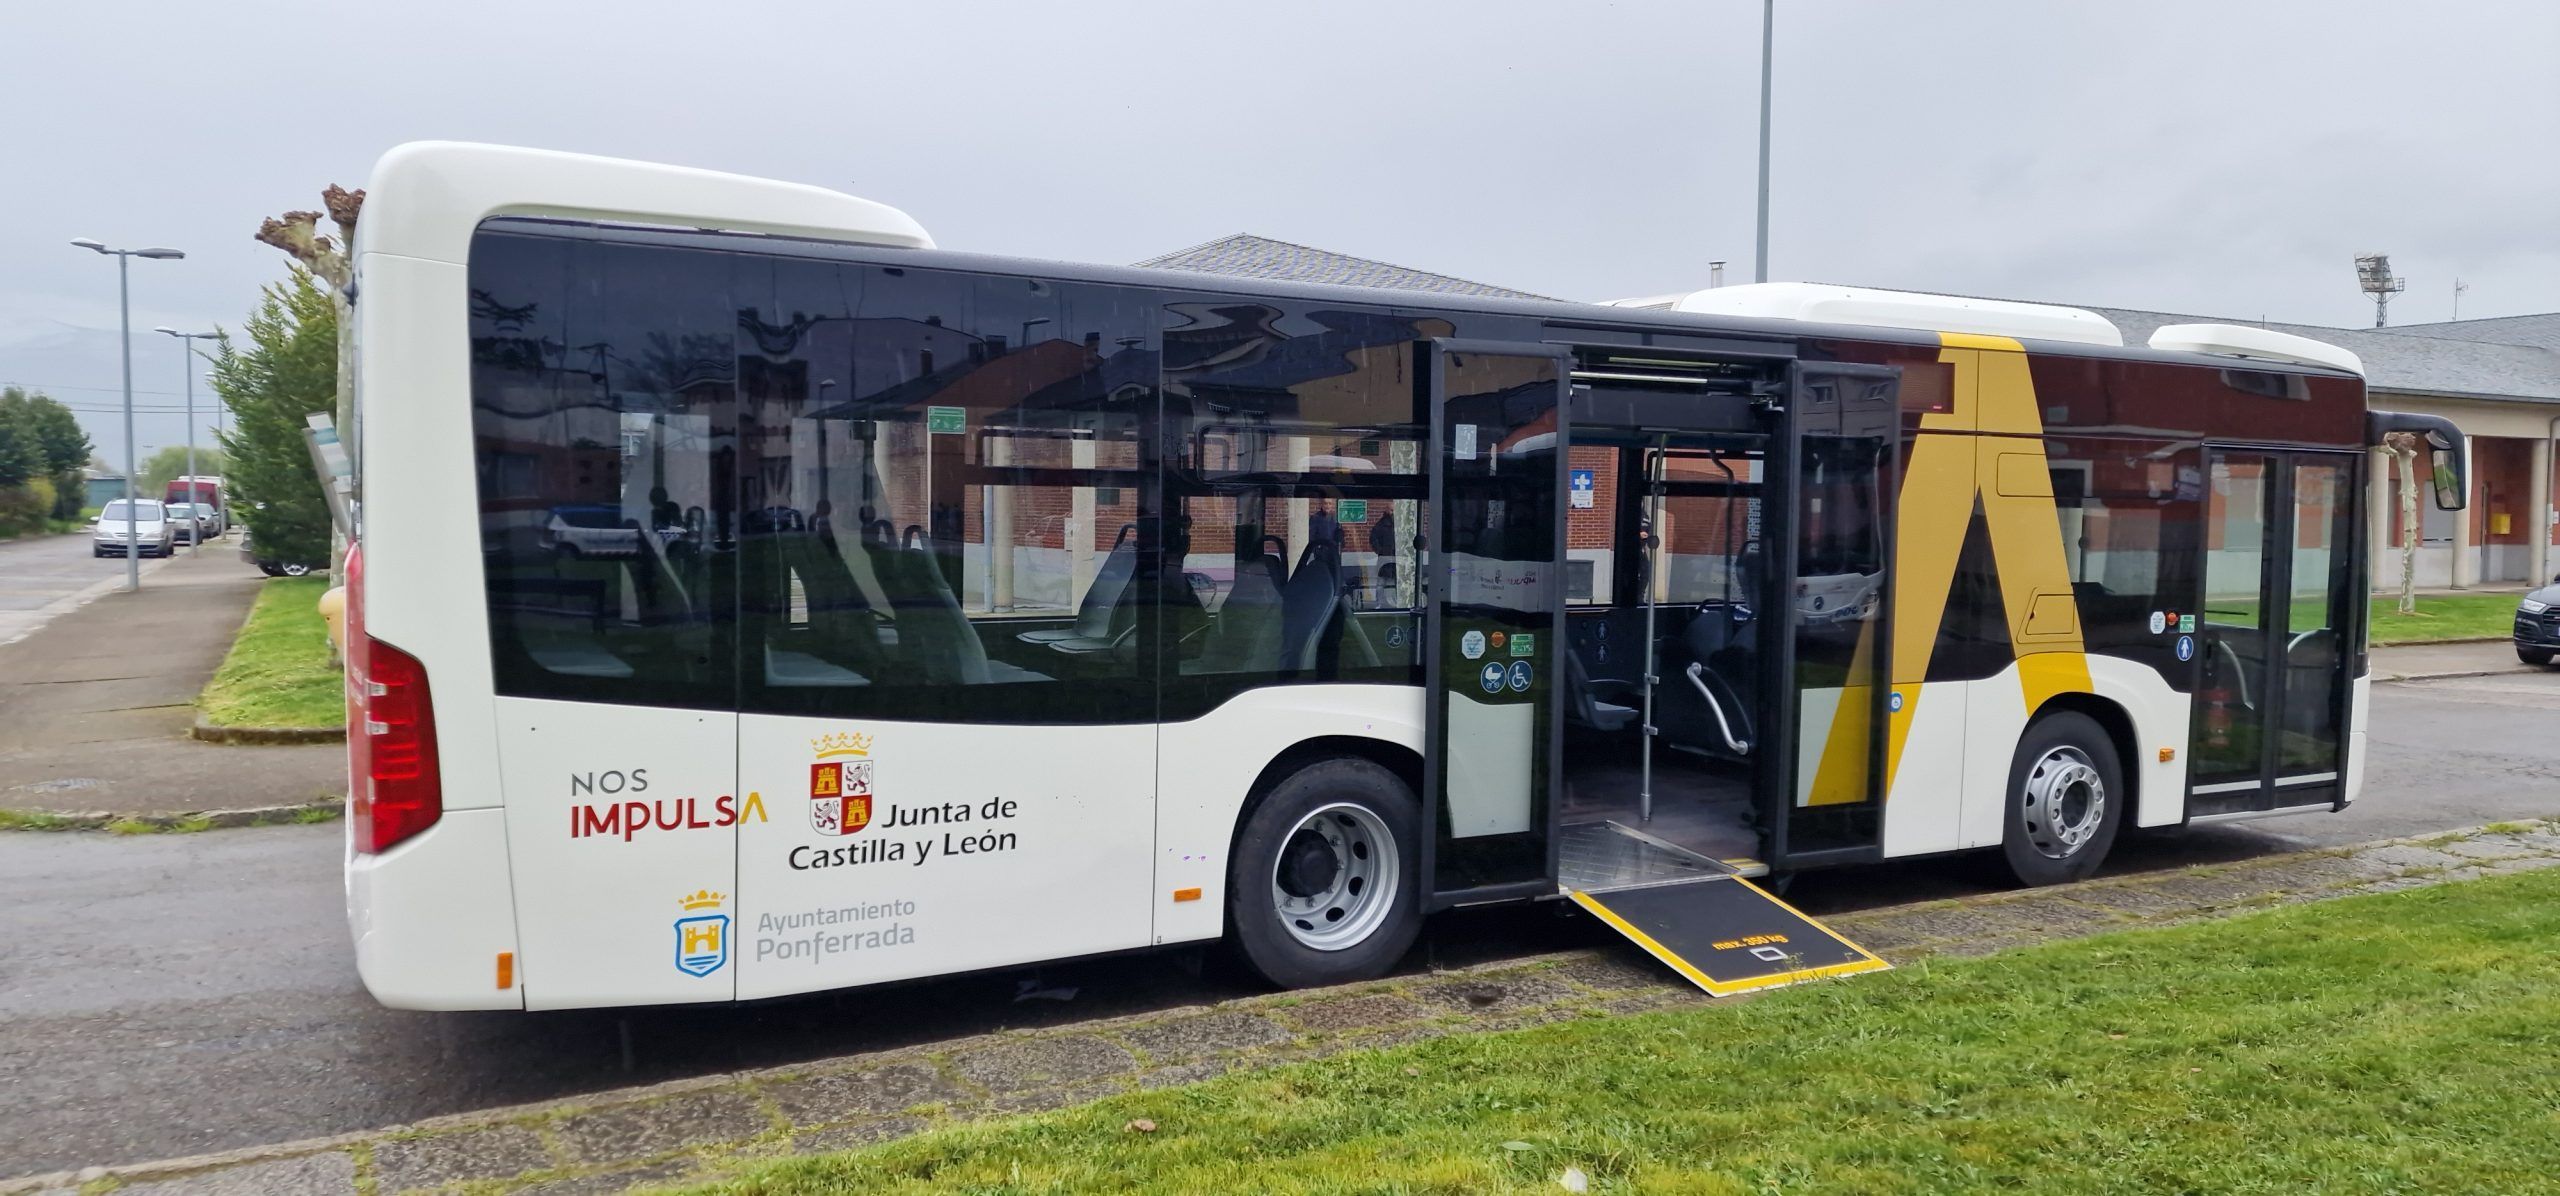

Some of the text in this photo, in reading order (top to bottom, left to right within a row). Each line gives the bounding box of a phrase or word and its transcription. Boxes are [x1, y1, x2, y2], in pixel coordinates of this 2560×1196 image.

[571, 768, 648, 797] NOS
[570, 791, 769, 843] IMPULSA
[880, 796, 1018, 829] Junta de
[788, 828, 1018, 871] Castilla y León
[757, 899, 916, 936] Ayuntamiento
[756, 922, 915, 965] Ponferrada
[1711, 940, 1747, 951] max.
[1765, 934, 1789, 943] kg
